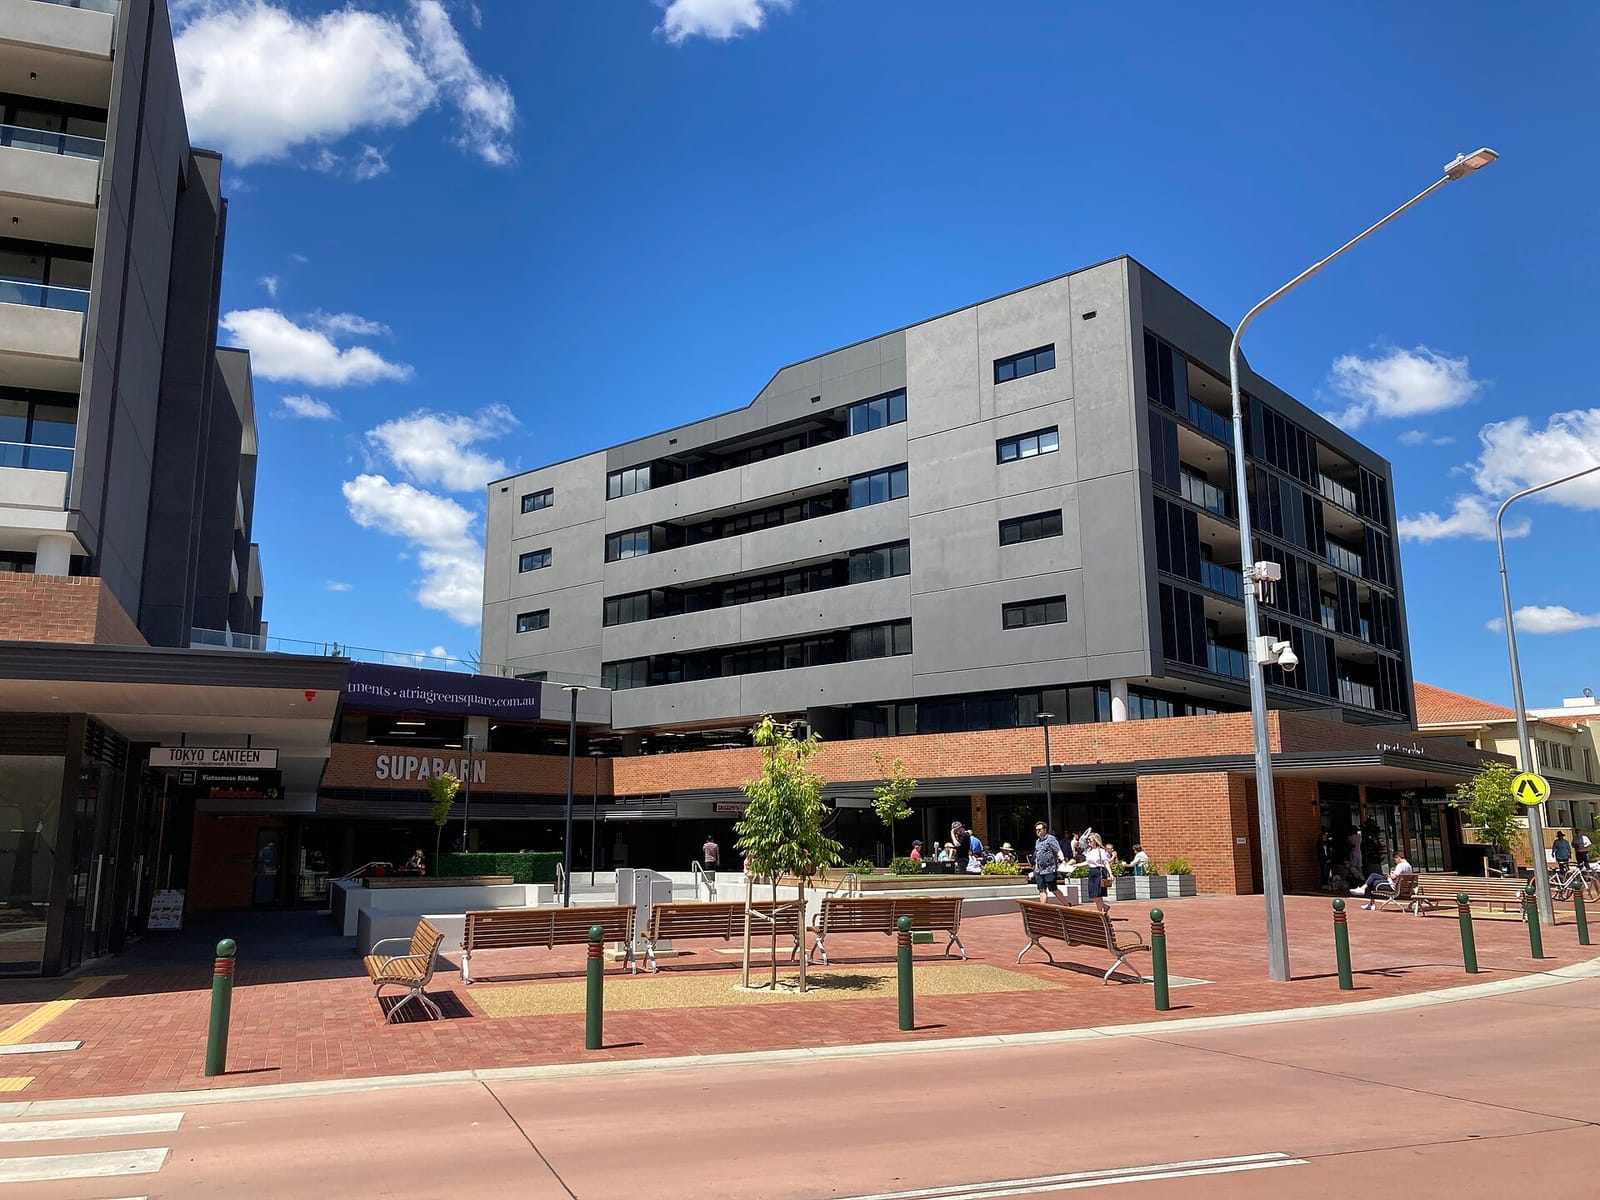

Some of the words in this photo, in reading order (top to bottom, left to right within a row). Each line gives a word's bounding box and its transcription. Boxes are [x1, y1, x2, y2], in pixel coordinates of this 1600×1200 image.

[399, 686, 536, 707] atriagreensquare.com.au
[169, 749, 205, 761] TOKYO
[212, 749, 261, 763] CANTEEN
[375, 754, 487, 784] SUPABARN
